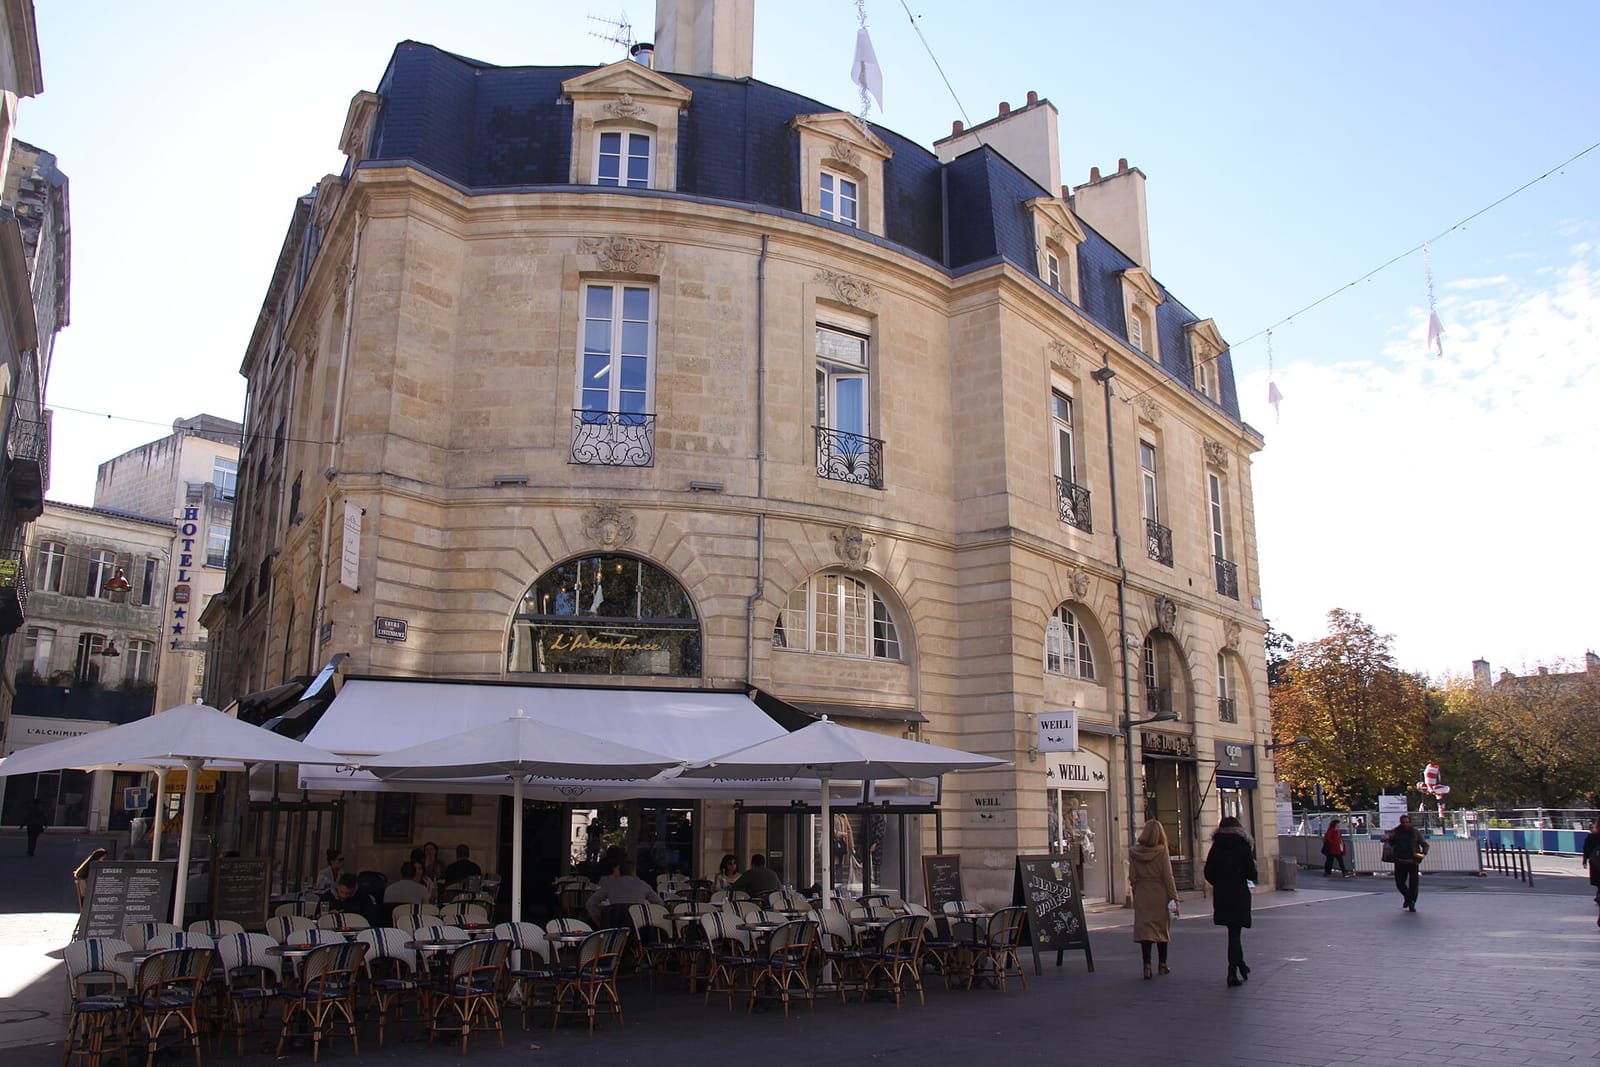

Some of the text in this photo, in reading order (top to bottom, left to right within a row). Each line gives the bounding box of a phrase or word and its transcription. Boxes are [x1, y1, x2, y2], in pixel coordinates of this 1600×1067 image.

[177, 507, 200, 582] HOTEL
[1040, 720, 1072, 729] WEILL
[1059, 764, 1089, 781] WEILL
[974, 797, 1001, 806] WEILL
